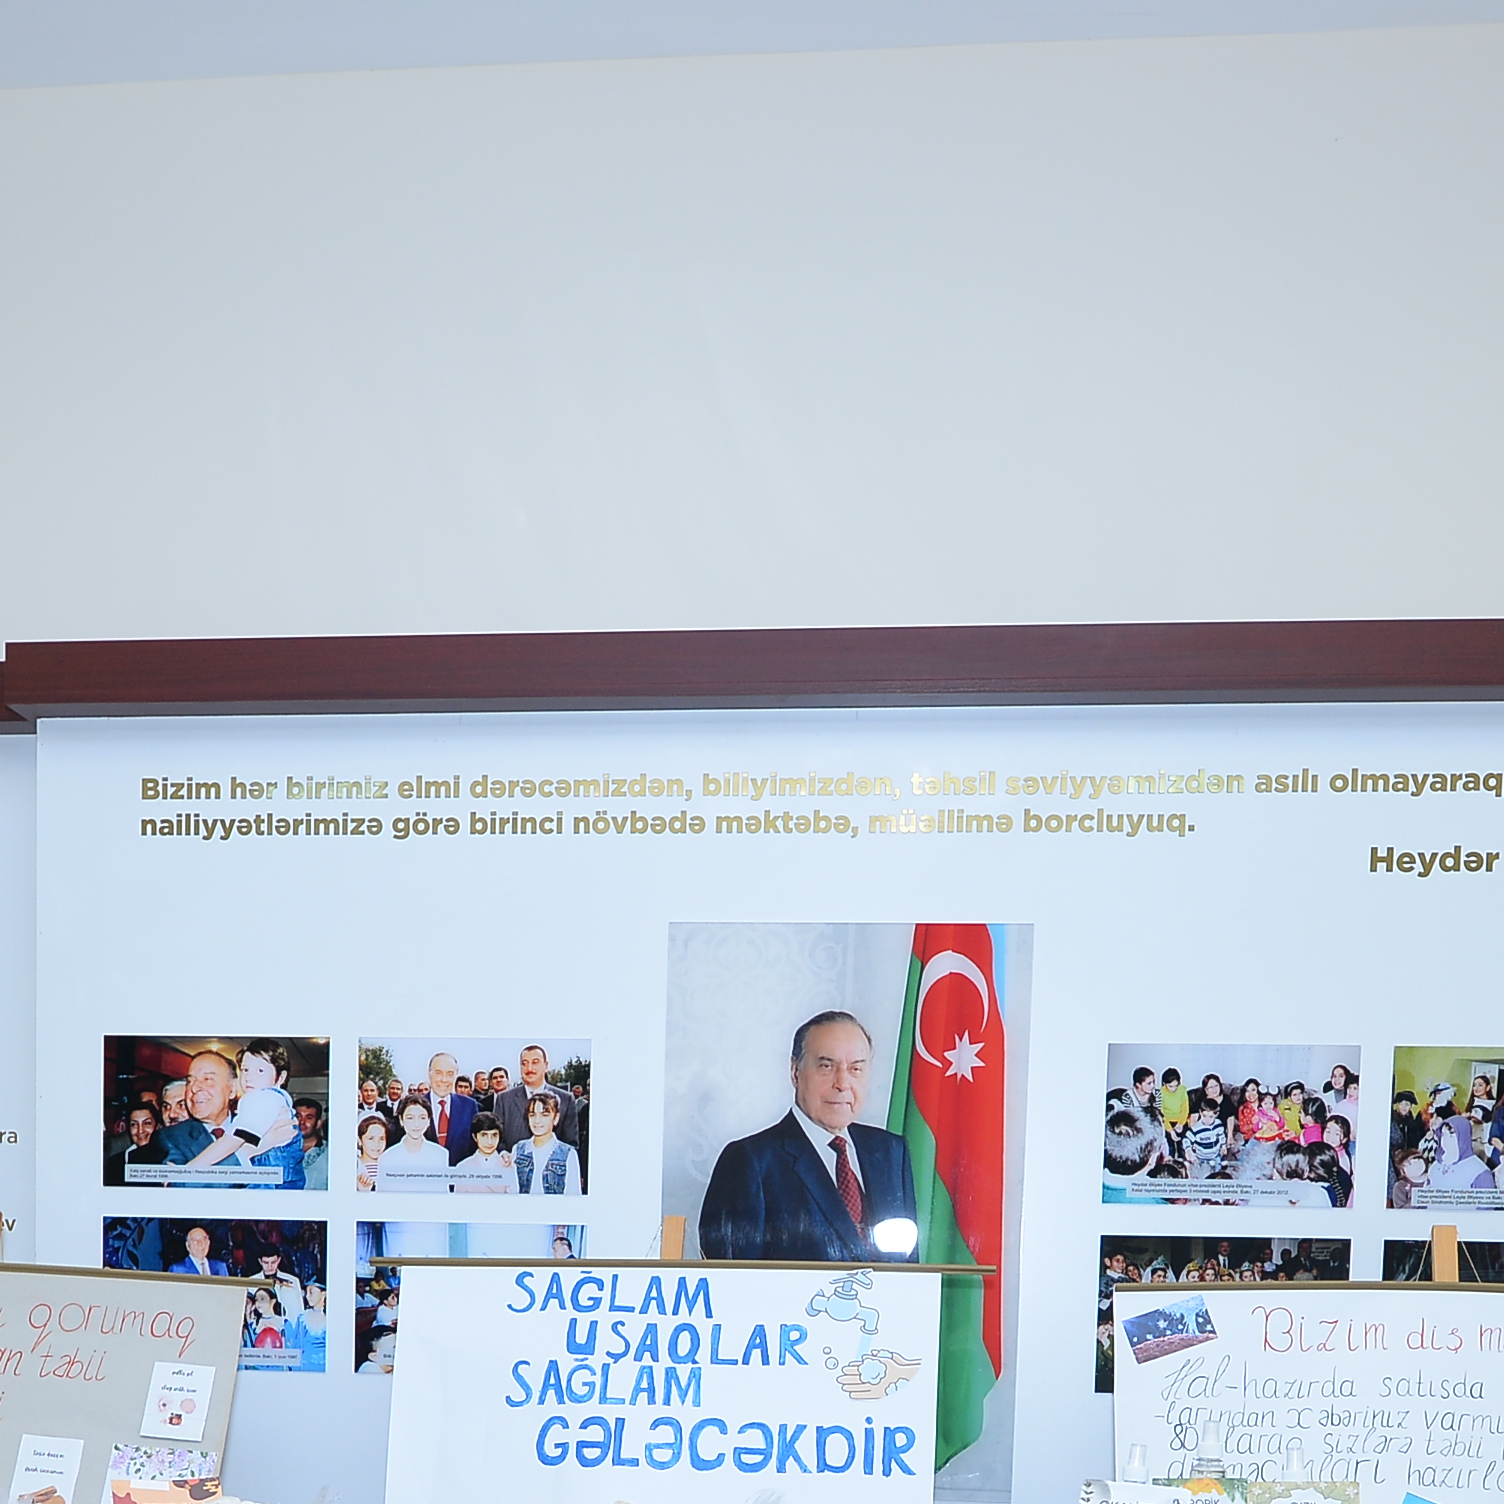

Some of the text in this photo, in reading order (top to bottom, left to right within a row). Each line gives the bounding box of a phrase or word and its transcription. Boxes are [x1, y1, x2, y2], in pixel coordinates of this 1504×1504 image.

[141, 777, 221, 801] Bizim
[230, 775, 277, 801] hər
[286, 774, 389, 800] birimiz
[398, 774, 460, 799] elmi
[469, 772, 693, 803] dərəcəmizdən,
[702, 771, 899, 802] biliyimizdən,
[910, 770, 994, 796] təhsil
[1005, 768, 1245, 801] səviyyəmizdən
[1254, 768, 1319, 794] asılı
[140, 808, 1196, 842] nailiyyətlərimizə görə birinci növbədə məktəbə, müəllimə borcluyuq.
[1369, 846, 1500, 879] Heydər
[506, 1269, 714, 1320] SAĞLAM
[28, 1301, 197, 1358] qorumaq
[566, 1318, 809, 1367] UŞAQLAR
[1251, 1305, 1388, 1353] Bizim
[1406, 1317, 1464, 1354] diş
[39, 1345, 107, 1383] təbii
[504, 1356, 703, 1409] SAĞLAM
[535, 1415, 918, 1478] GƏLƏCƏKDİR
[1322, 1427, 1413, 1456] sizlərə
[1425, 1435, 1483, 1460] təbii
